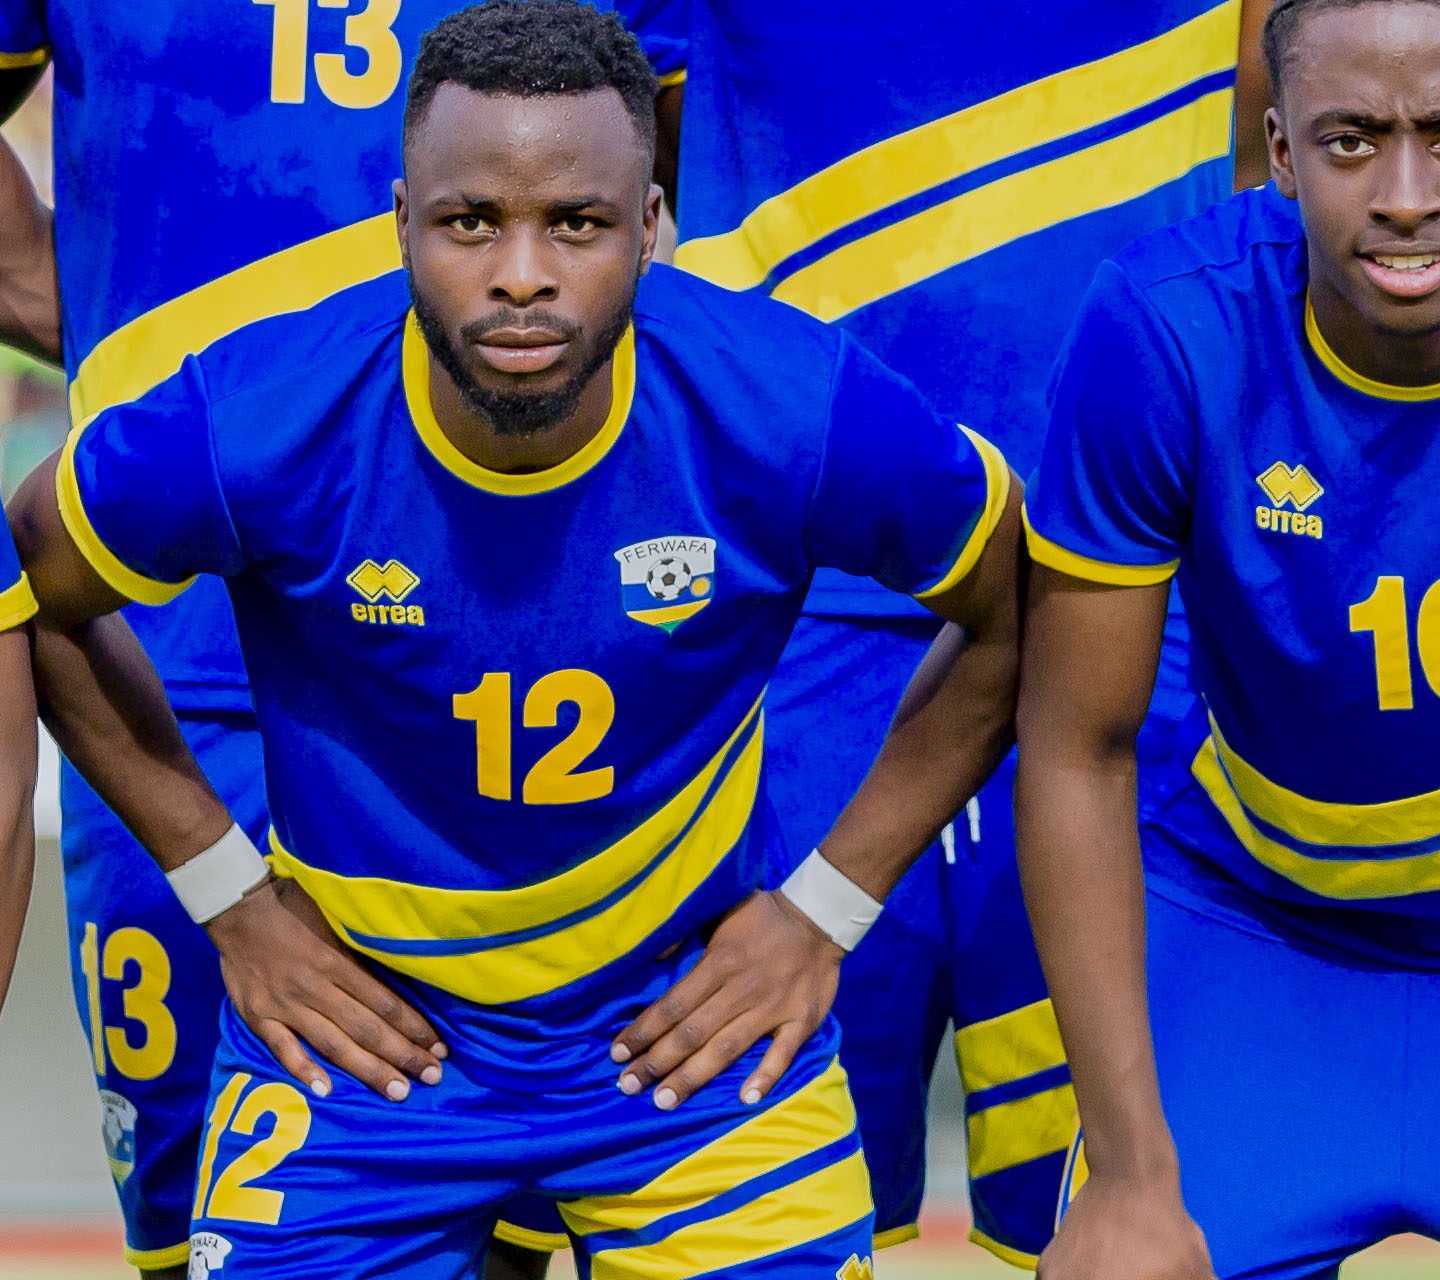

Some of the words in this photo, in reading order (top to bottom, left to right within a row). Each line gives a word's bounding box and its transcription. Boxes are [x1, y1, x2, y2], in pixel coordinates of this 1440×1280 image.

[623, 539, 708, 564] FERWAFA
[1255, 505, 1324, 540] errea
[351, 602, 426, 627] errea
[452, 668, 616, 805] 12
[80, 922, 177, 1081] 13
[192, 1072, 312, 1226] 12
